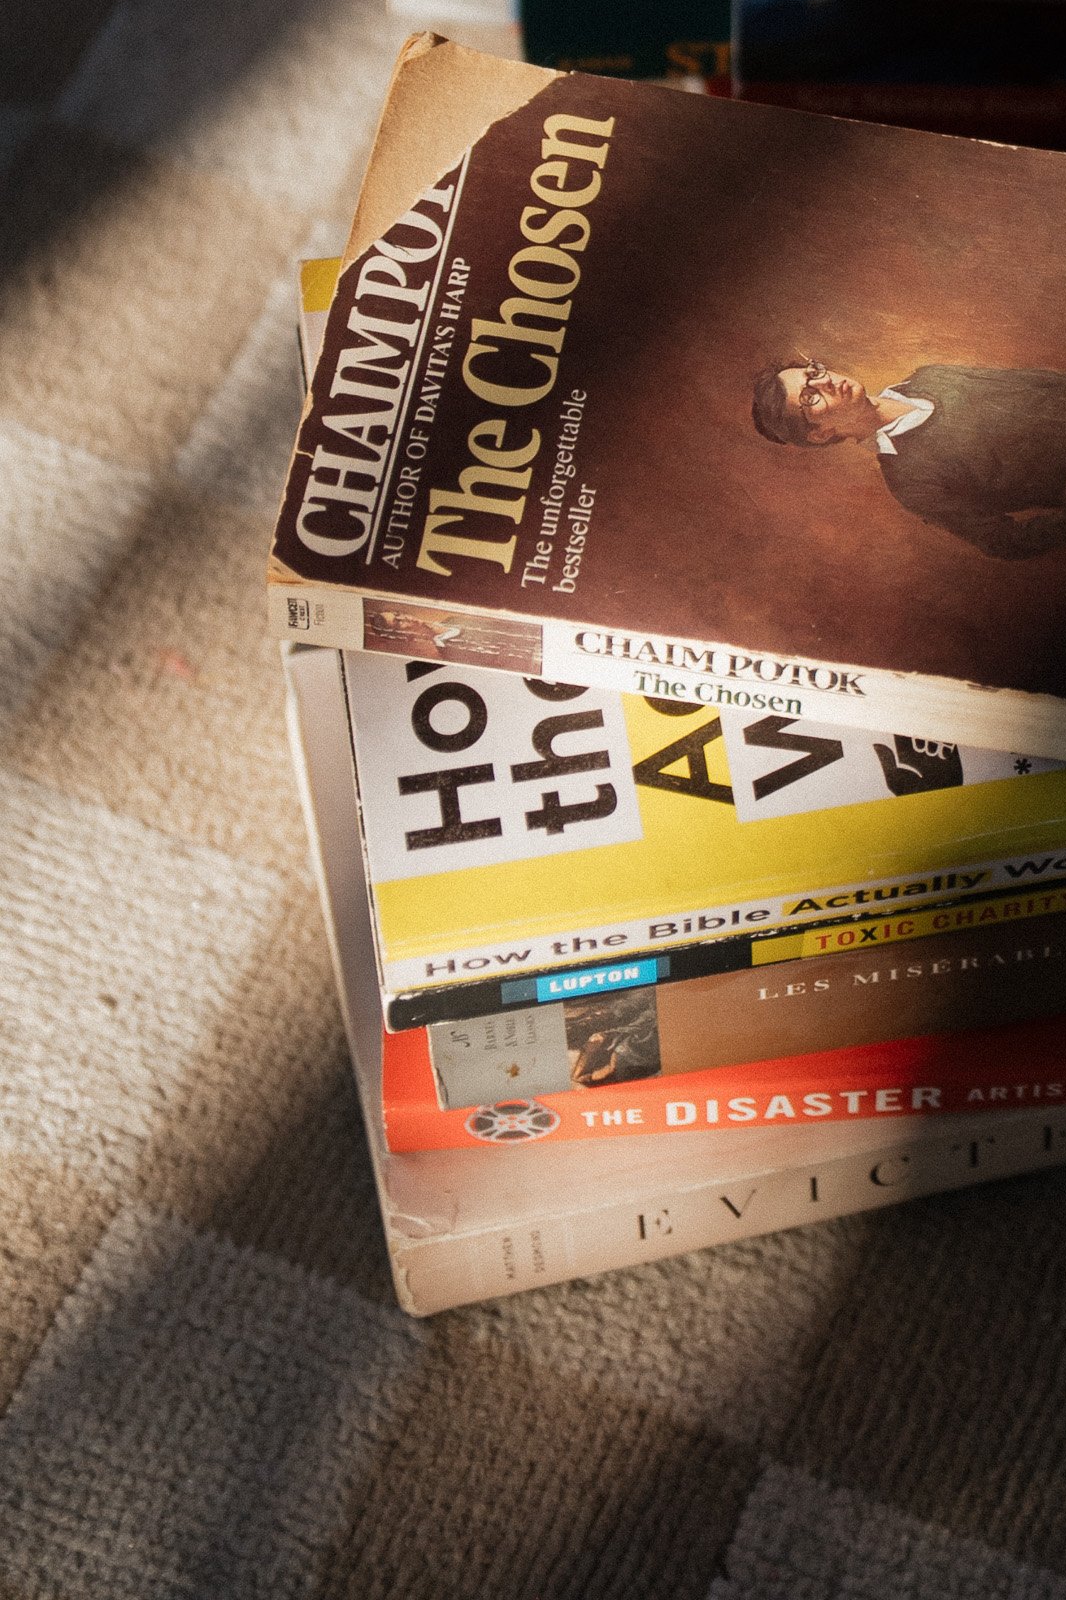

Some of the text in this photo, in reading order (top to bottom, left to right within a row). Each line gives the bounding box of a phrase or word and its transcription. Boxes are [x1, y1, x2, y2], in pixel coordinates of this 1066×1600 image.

[460, 111, 617, 408] Chosen
[295, 305, 422, 558] CHAIM
[382, 255, 473, 570] AUTHOR OF DAVITA'S HARP
[415, 417, 543, 578] The
[520, 387, 589, 590] The unforgettable
[552, 483, 598, 595] bestseller
[574, 631, 868, 697] CHAIM POTOK
[632, 669, 804, 716] The Chosen
[397, 661, 503, 852] Ho
[423, 947, 532, 978] How
[551, 931, 630, 958] the
[648, 905, 773, 941] Bible
[787, 866, 991, 917] Actually
[815, 919, 916, 951] TOXIC
[548, 967, 640, 994] LUPTON
[757, 978, 832, 1001] LES
[581, 1107, 645, 1128] THE
[664, 1086, 942, 1127] DISASTER
